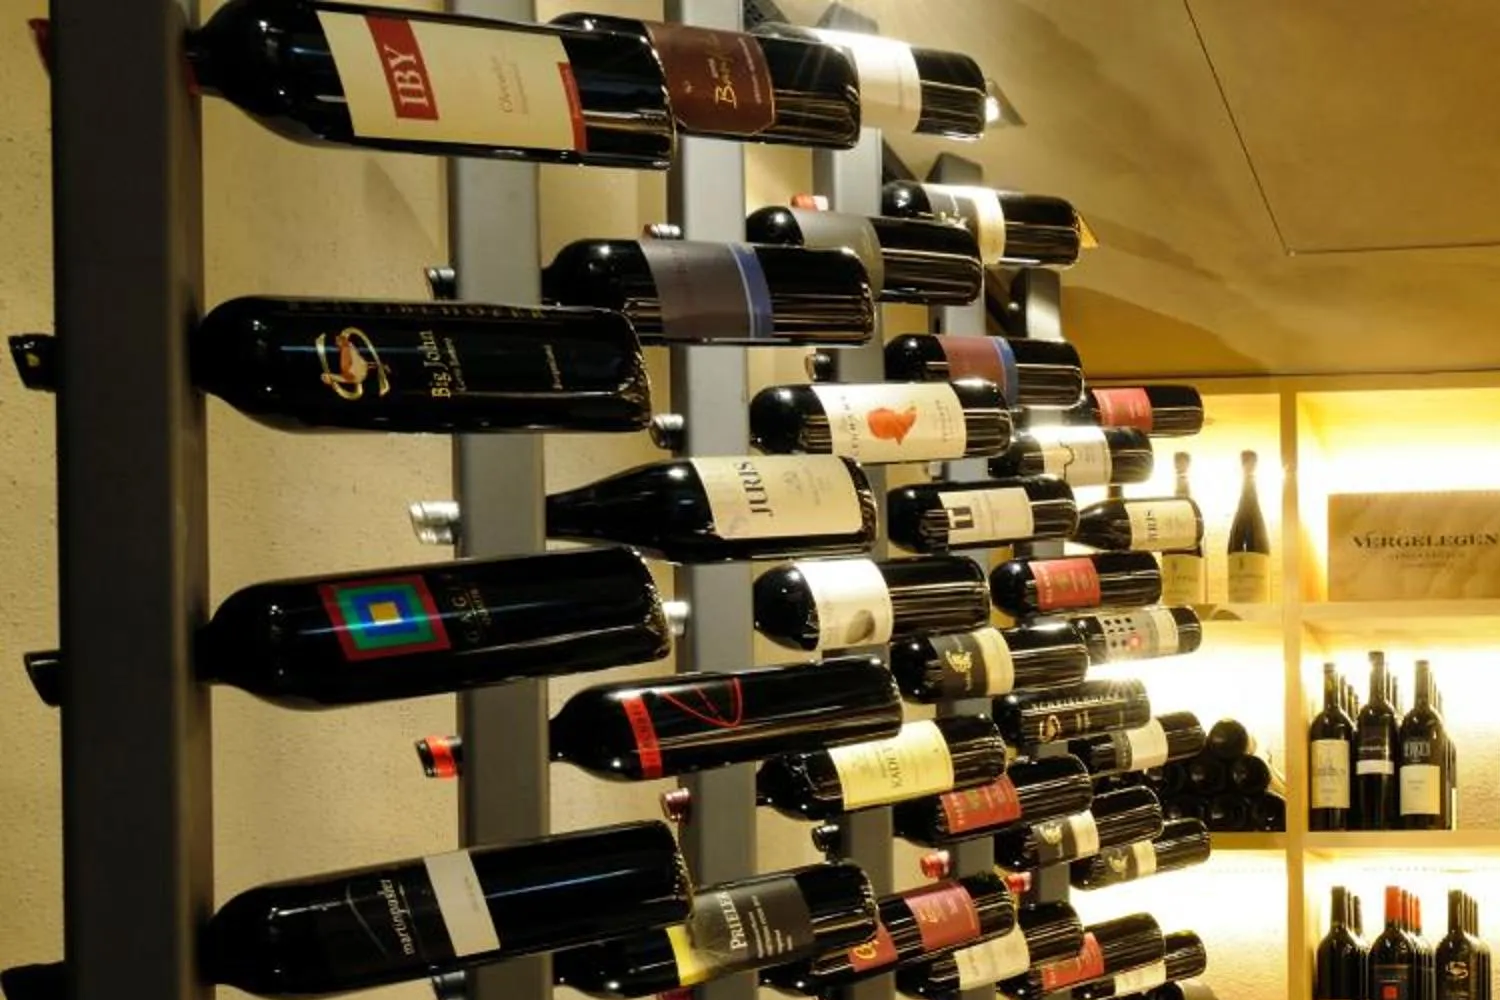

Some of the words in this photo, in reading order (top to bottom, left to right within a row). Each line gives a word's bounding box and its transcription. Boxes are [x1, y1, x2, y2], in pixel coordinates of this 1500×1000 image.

[384, 44, 430, 108] IBY
[418, 329, 449, 371] John
[738, 460, 774, 518] JURIS
